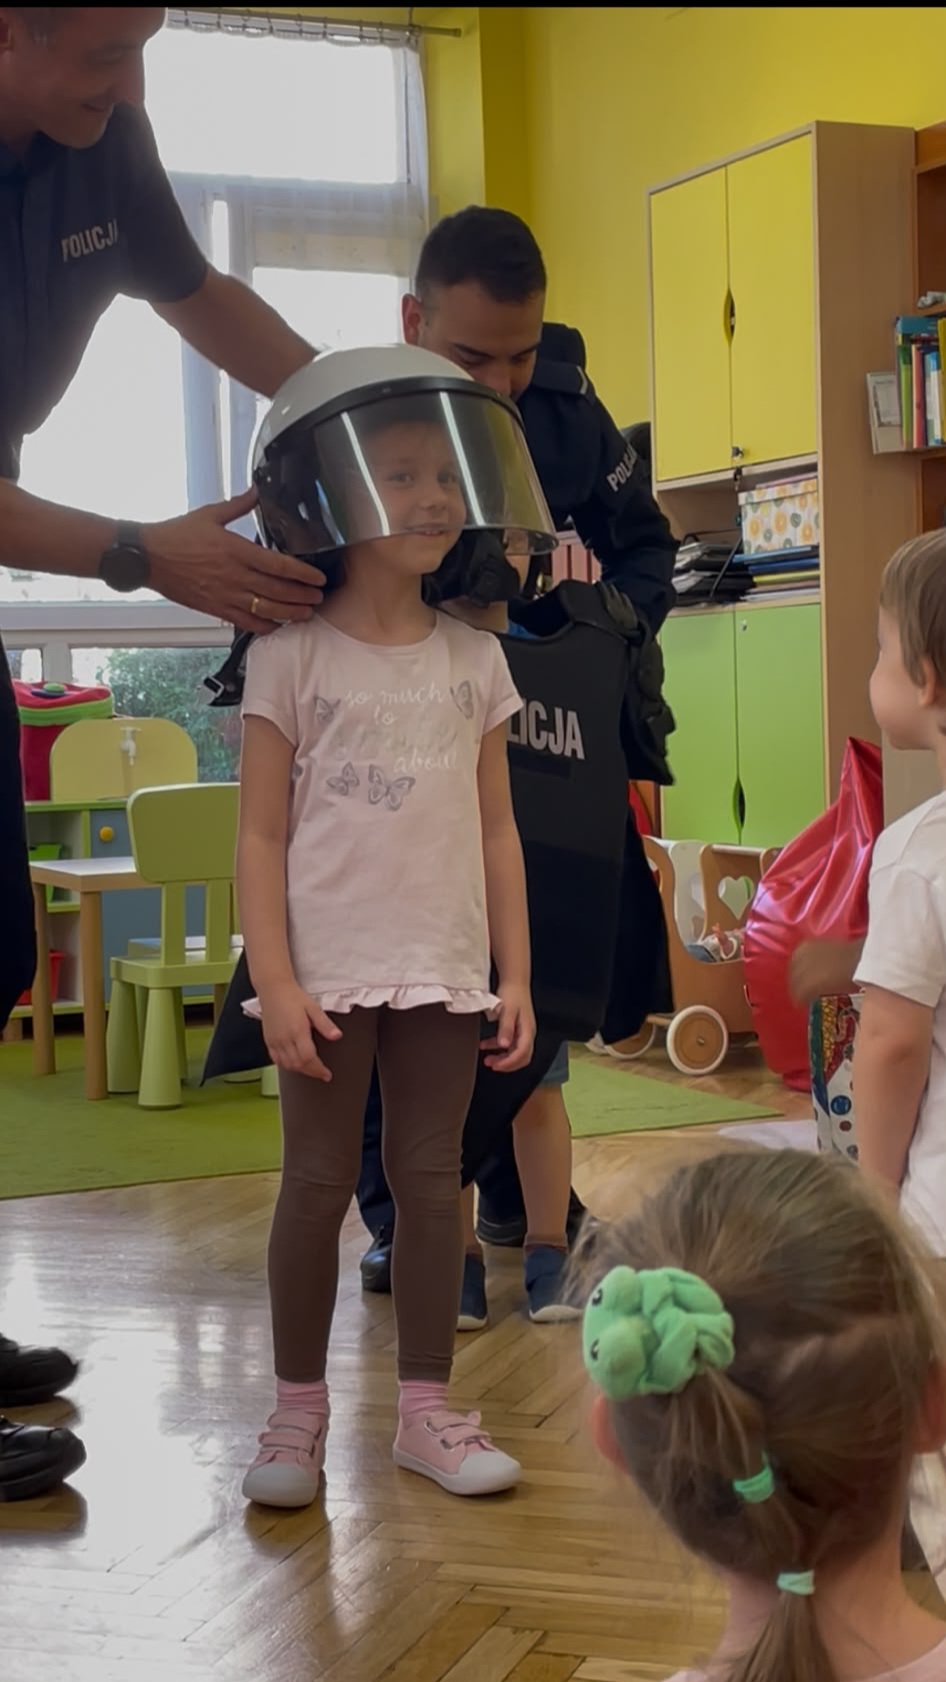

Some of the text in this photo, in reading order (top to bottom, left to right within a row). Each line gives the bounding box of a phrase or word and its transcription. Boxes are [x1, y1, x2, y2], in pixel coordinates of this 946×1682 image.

[344, 681, 444, 709] so much
[506, 698, 585, 760] LICJA
